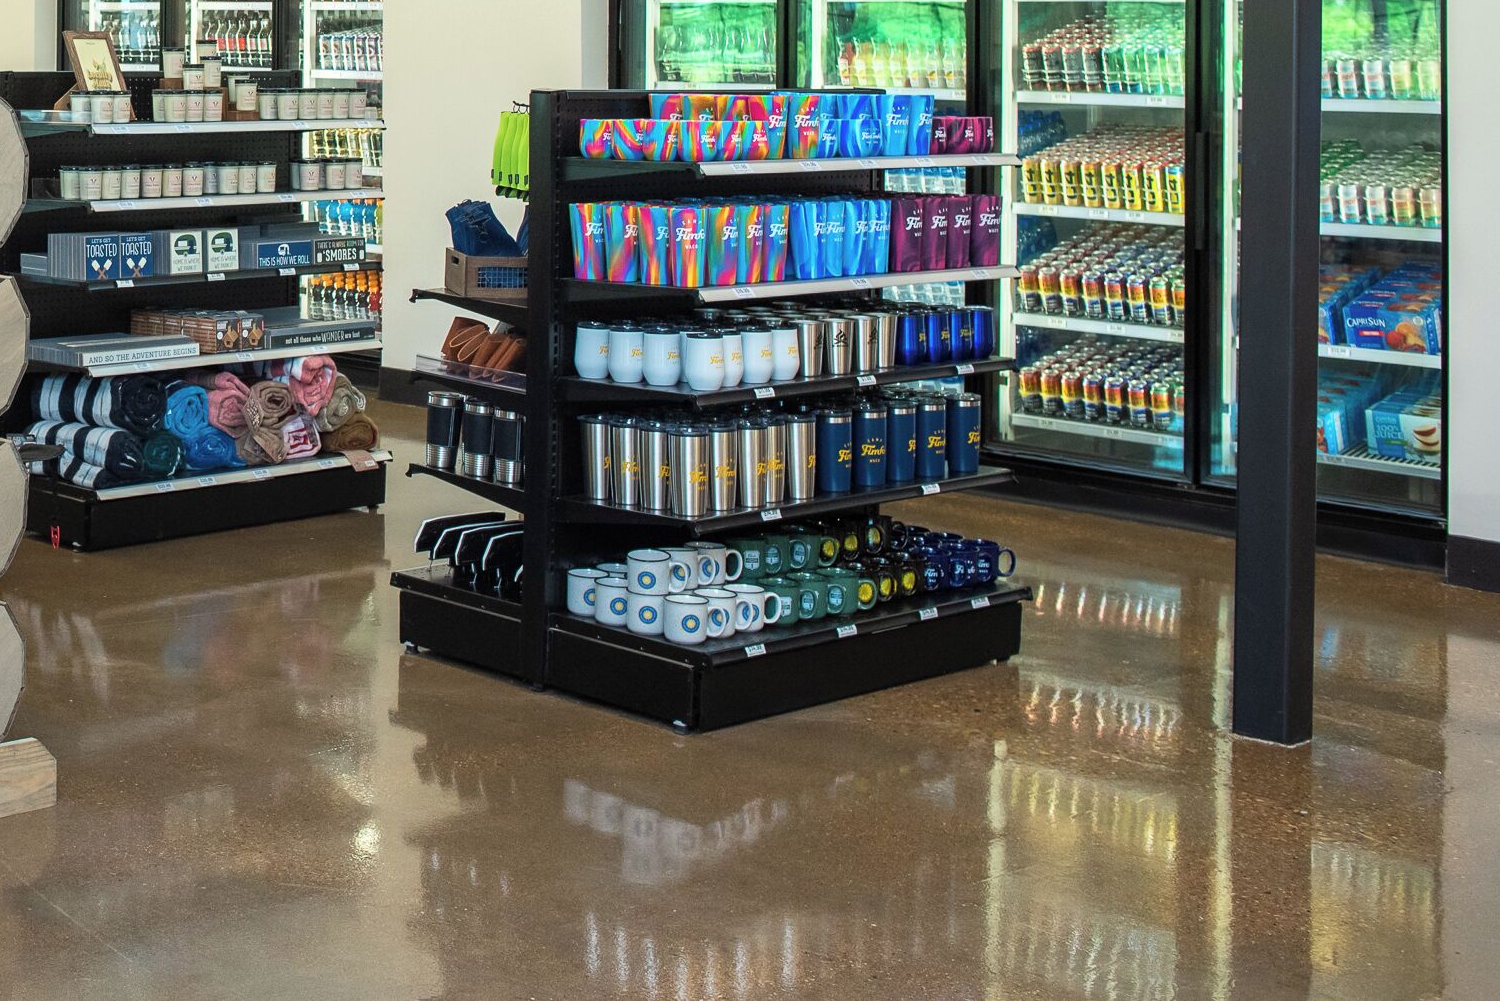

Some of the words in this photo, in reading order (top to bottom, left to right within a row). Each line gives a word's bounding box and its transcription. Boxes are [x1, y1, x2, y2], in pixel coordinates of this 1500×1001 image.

[86, 244, 117, 258] TOASTED
[120, 241, 151, 256] TOASTED
[260, 257, 270, 266] THIS
[271, 257, 276, 266] IS
[276, 256, 288, 266] HOW
[288, 256, 297, 265] WE
[298, 255, 310, 264] ROLL
[321, 331, 344, 342] WANDER
[116, 353, 129, 361] THE
[132, 350, 171, 359] ADVENTURE
[173, 347, 197, 355] BEGINS
[1374, 431, 1404, 439] JUICE
